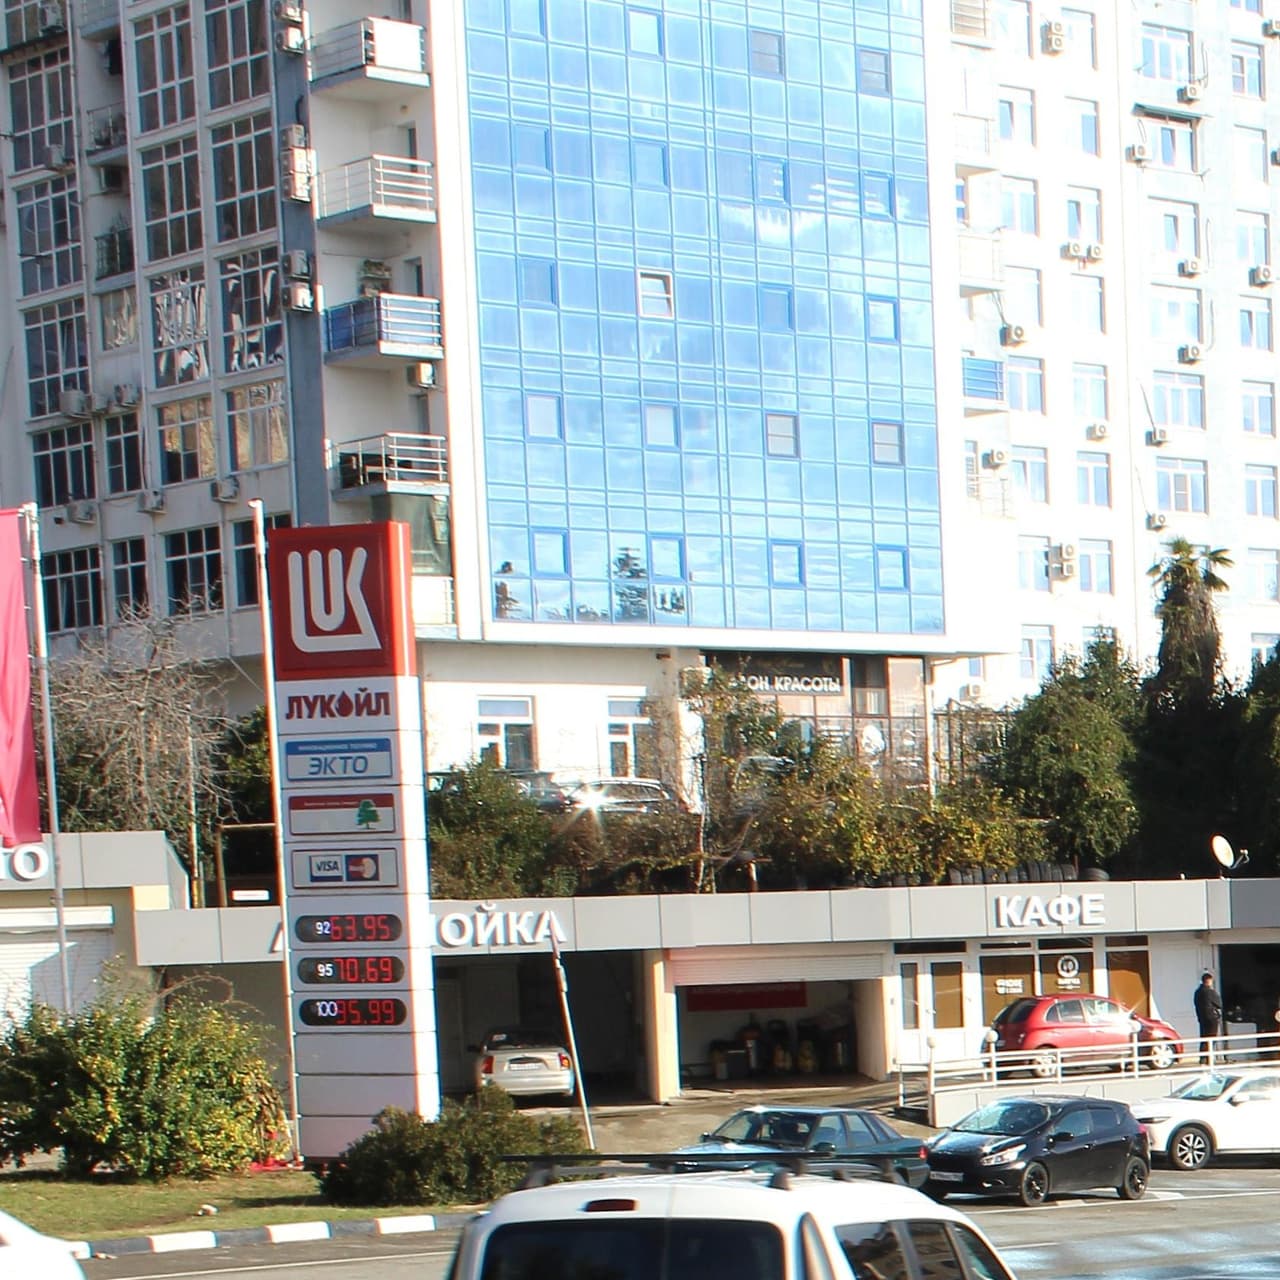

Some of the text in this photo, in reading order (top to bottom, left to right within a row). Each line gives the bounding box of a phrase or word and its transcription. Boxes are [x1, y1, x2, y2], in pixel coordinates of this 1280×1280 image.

[775, 675, 840, 692] КРАСОТЫ
[286, 687, 391, 719] ЛУКОЙЛ
[308, 756, 369, 775] ЭКТО
[316, 860, 339, 872] VISA
[998, 893, 1105, 927] КАФЕ
[316, 916, 390, 940] 92 63.95
[430, 903, 568, 946] ОЙКА
[317, 958, 393, 982] 95 70.69
[316, 1001, 338, 1017] 100
